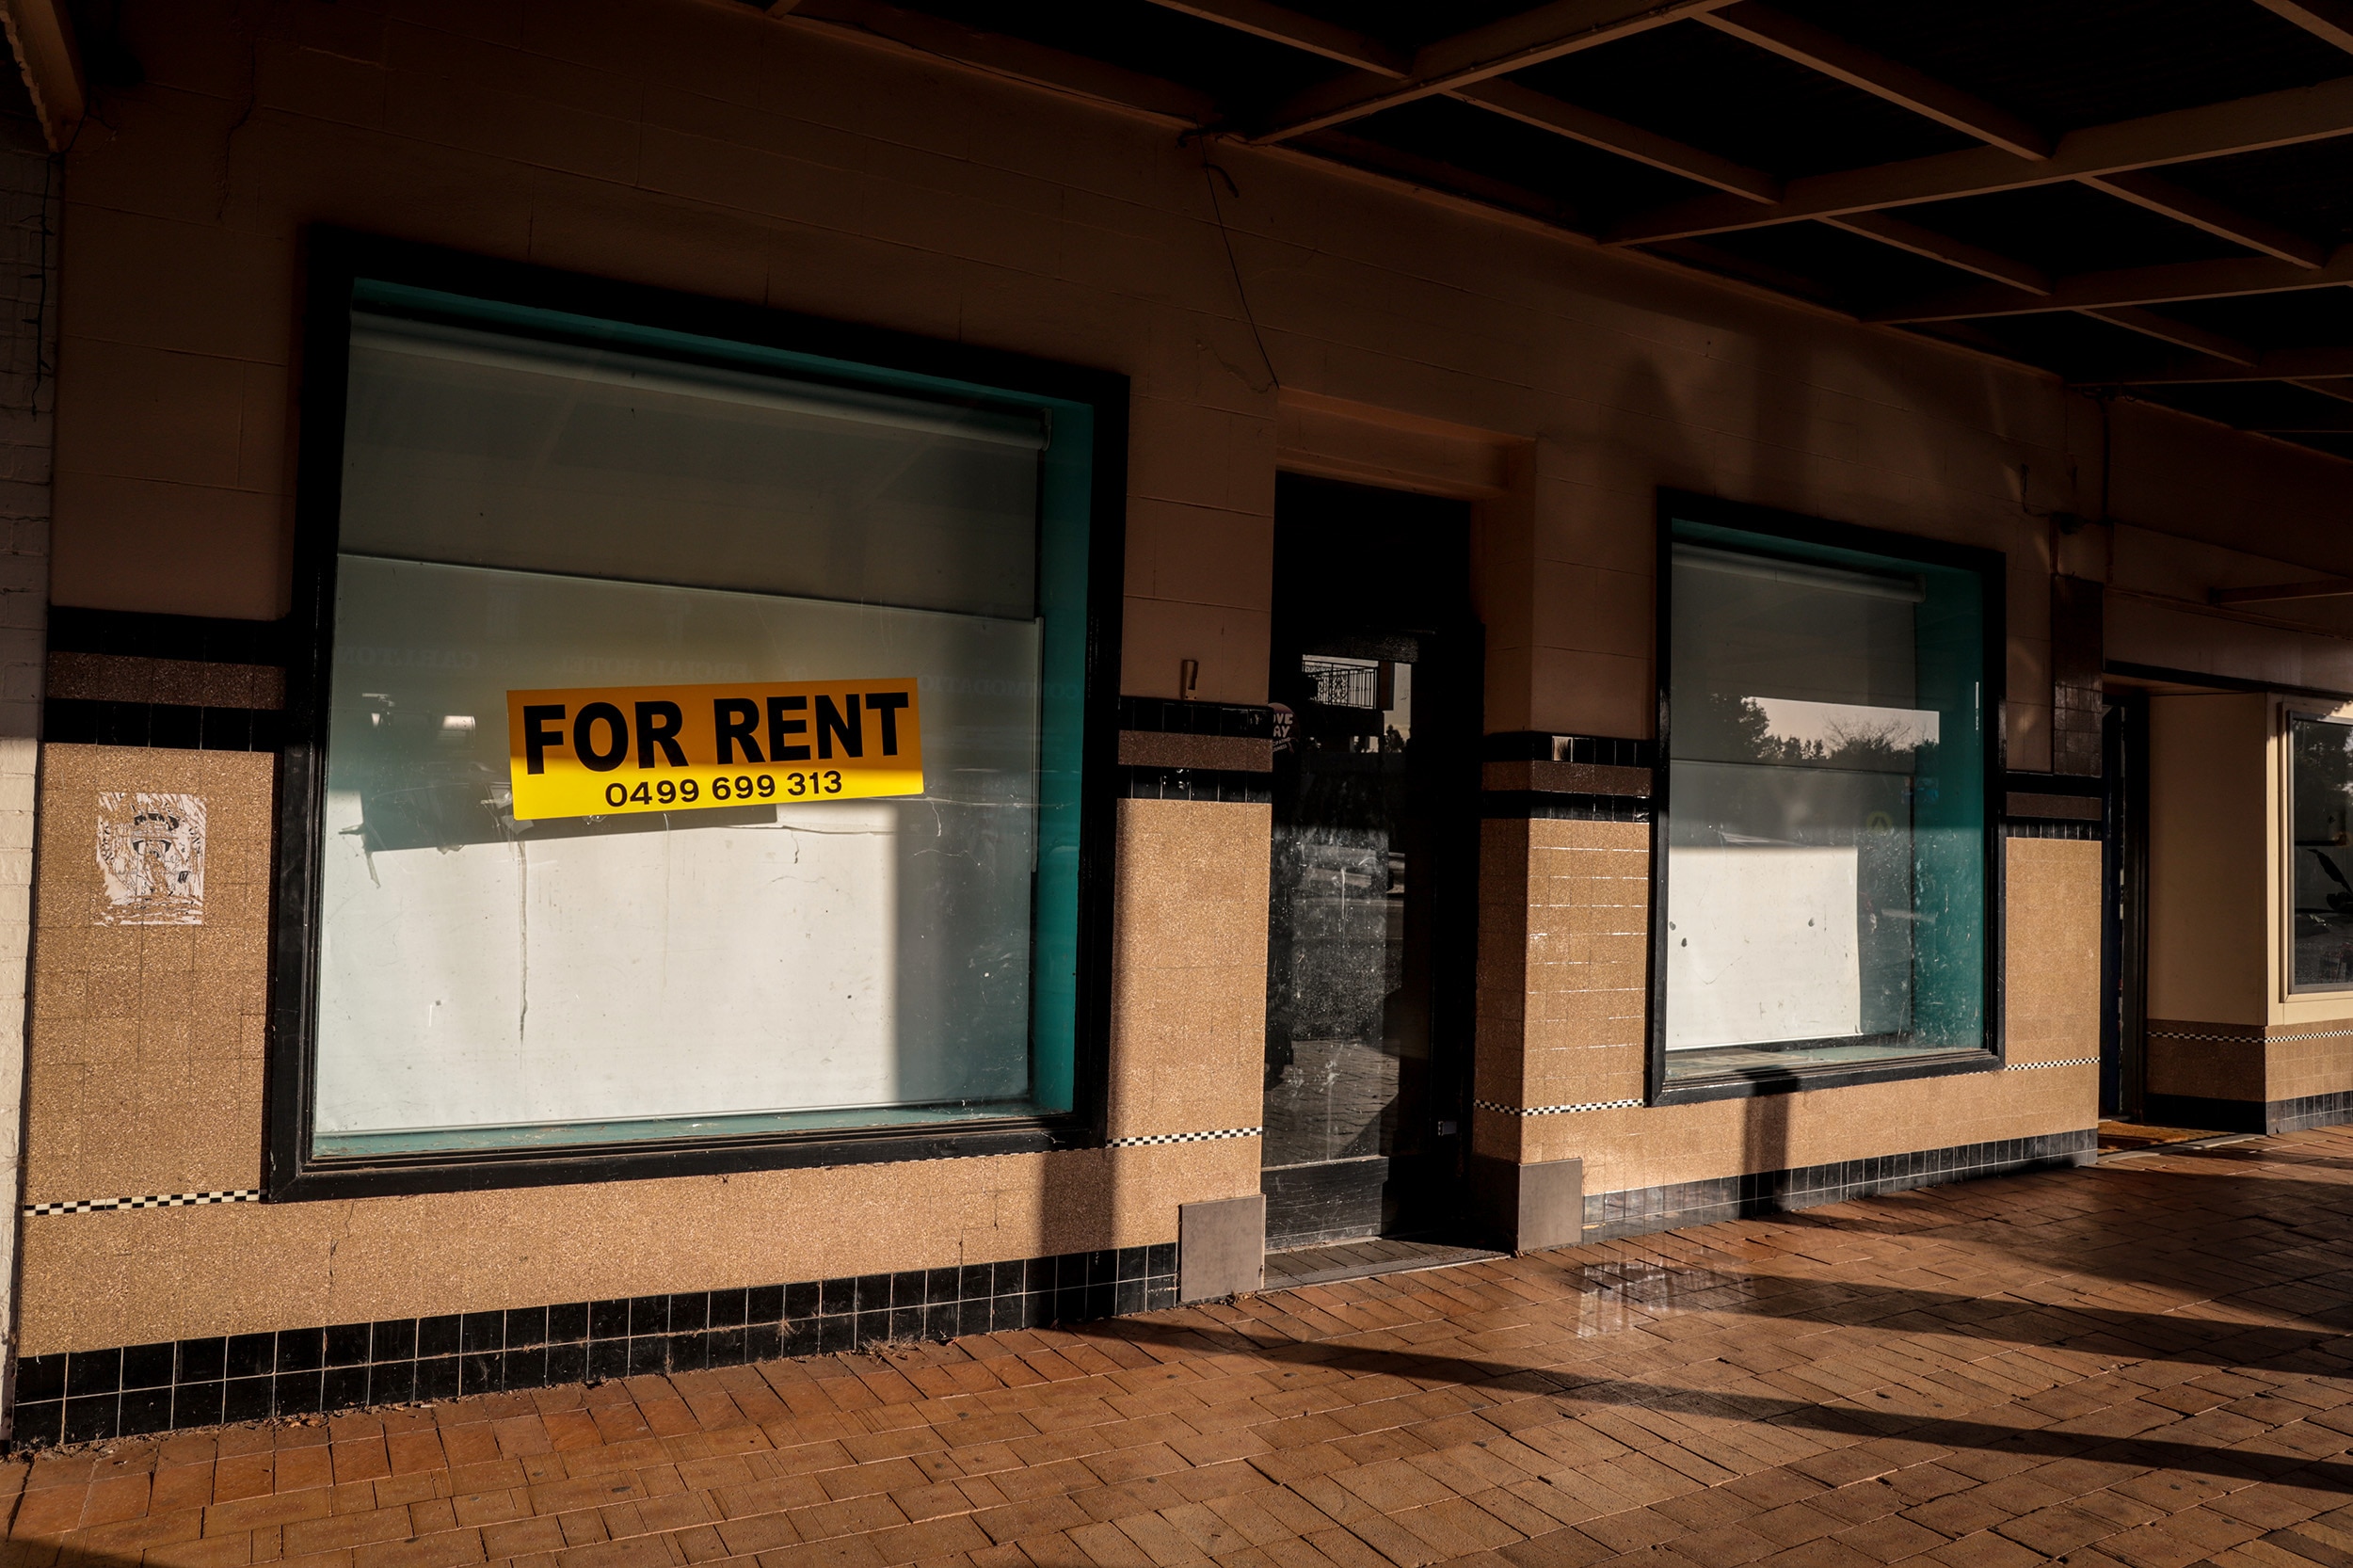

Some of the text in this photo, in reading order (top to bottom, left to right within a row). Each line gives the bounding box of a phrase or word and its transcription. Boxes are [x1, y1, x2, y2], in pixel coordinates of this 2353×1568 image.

[523, 692, 909, 775] FOR RENT
[605, 770, 842, 807] 0499 699 313
